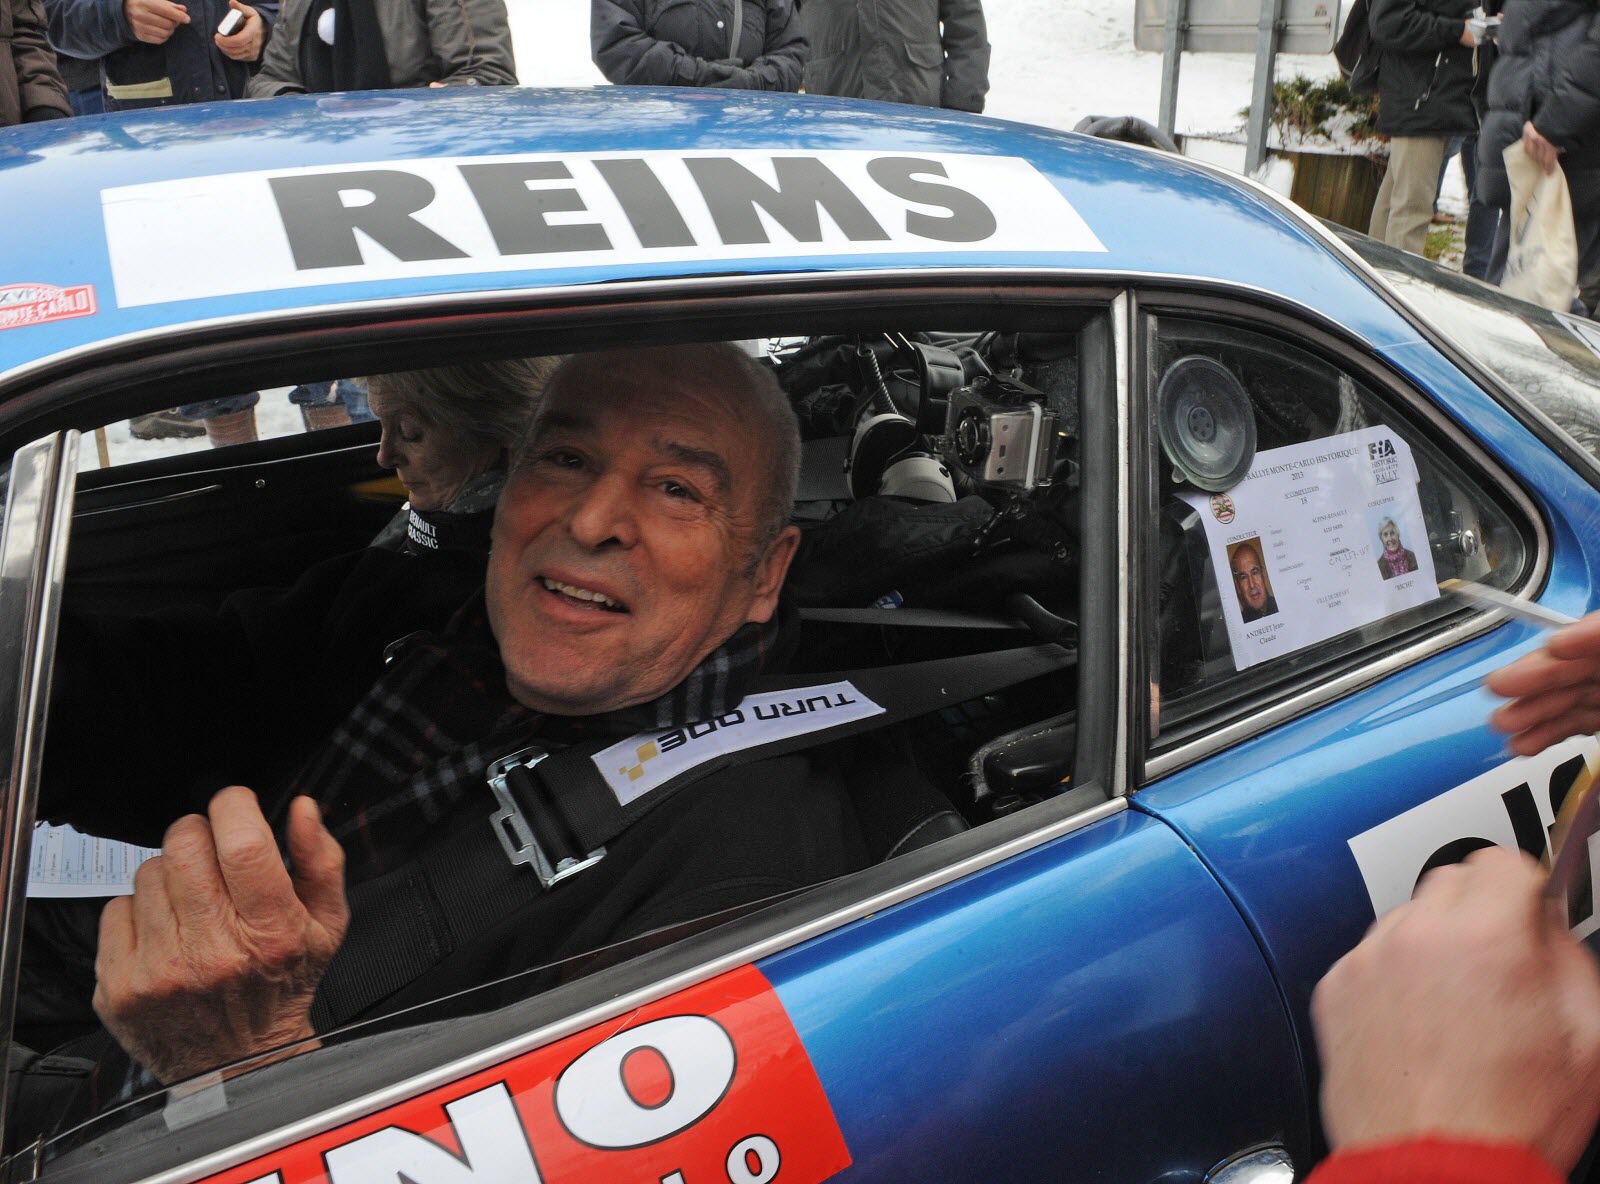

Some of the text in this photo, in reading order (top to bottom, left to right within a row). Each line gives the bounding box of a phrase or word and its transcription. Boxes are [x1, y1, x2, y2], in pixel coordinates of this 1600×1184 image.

[268, 157, 997, 270] REIMS
[1247, 448, 1359, 482] RALLYE MONTE-CARLO HISTORIQUE
[1291, 472, 1304, 481] 2013
[1245, 625, 1273, 640] ANDRUET
[1259, 634, 1277, 645] Claude
[753, 693, 856, 721] TURN
